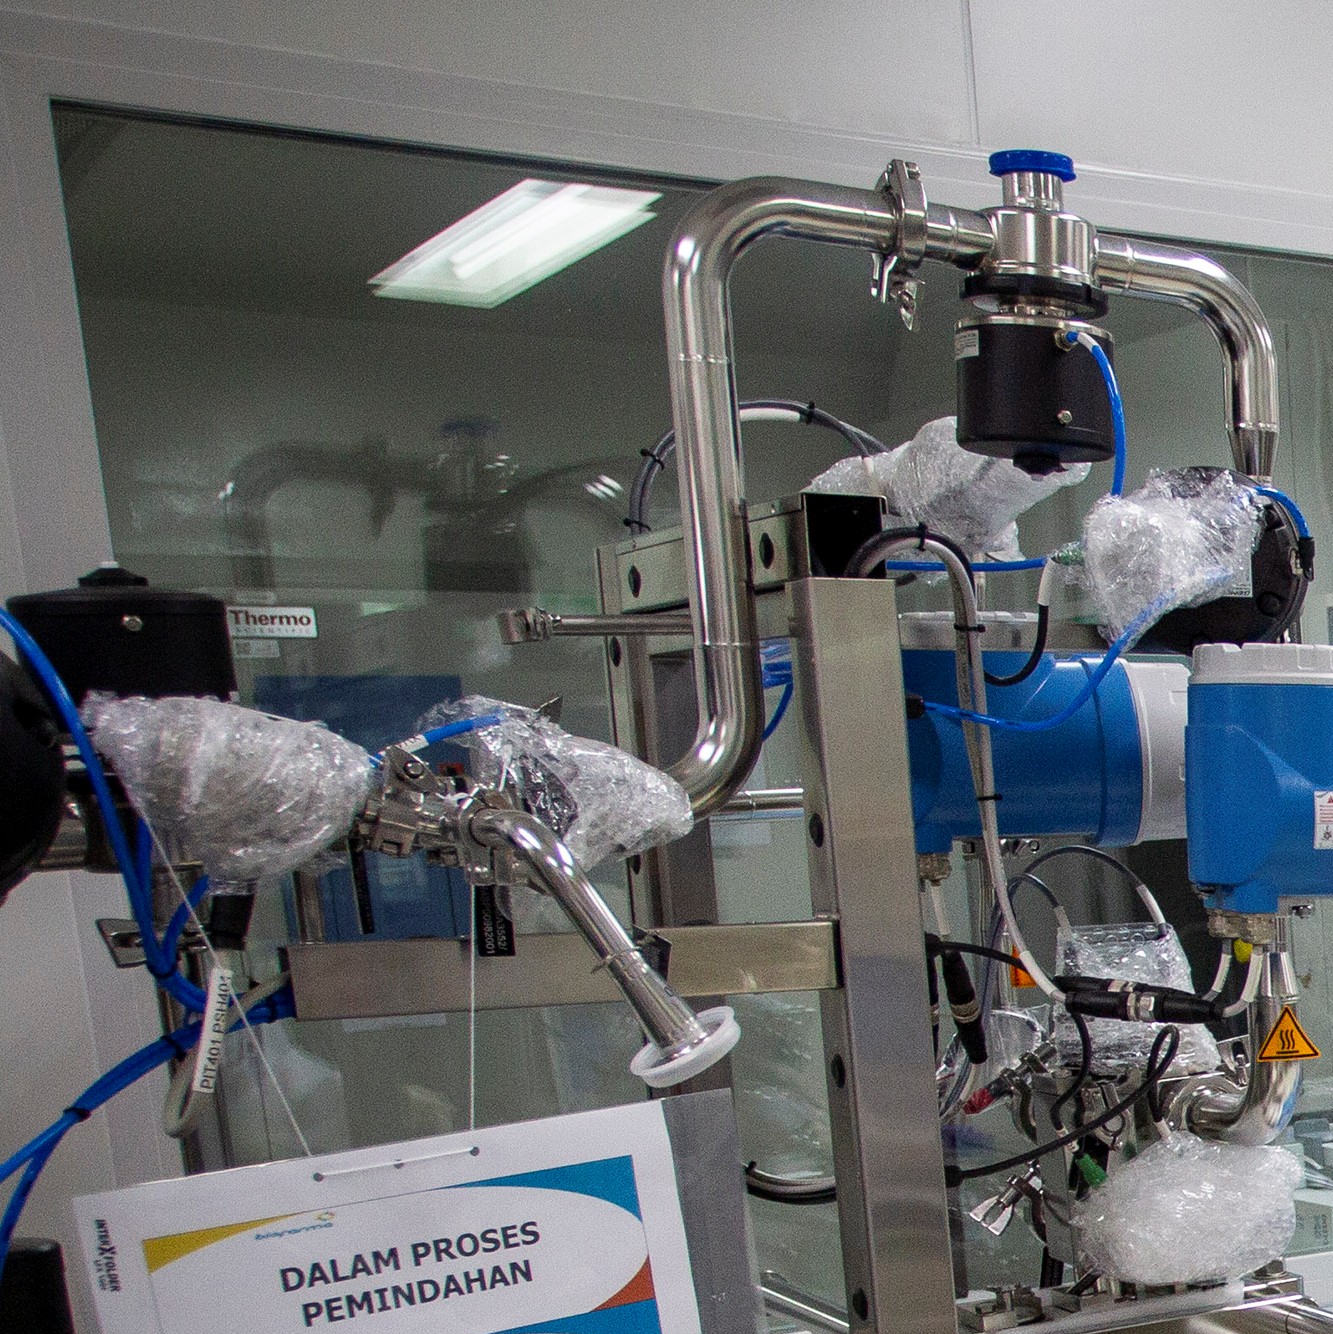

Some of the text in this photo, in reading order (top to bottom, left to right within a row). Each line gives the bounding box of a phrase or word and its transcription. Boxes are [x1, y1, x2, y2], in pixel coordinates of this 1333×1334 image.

[228, 609, 312, 626] Thermo
[280, 1221, 541, 1293] DALAM PROSES
[302, 1259, 533, 1327] PEMINDAHAN
